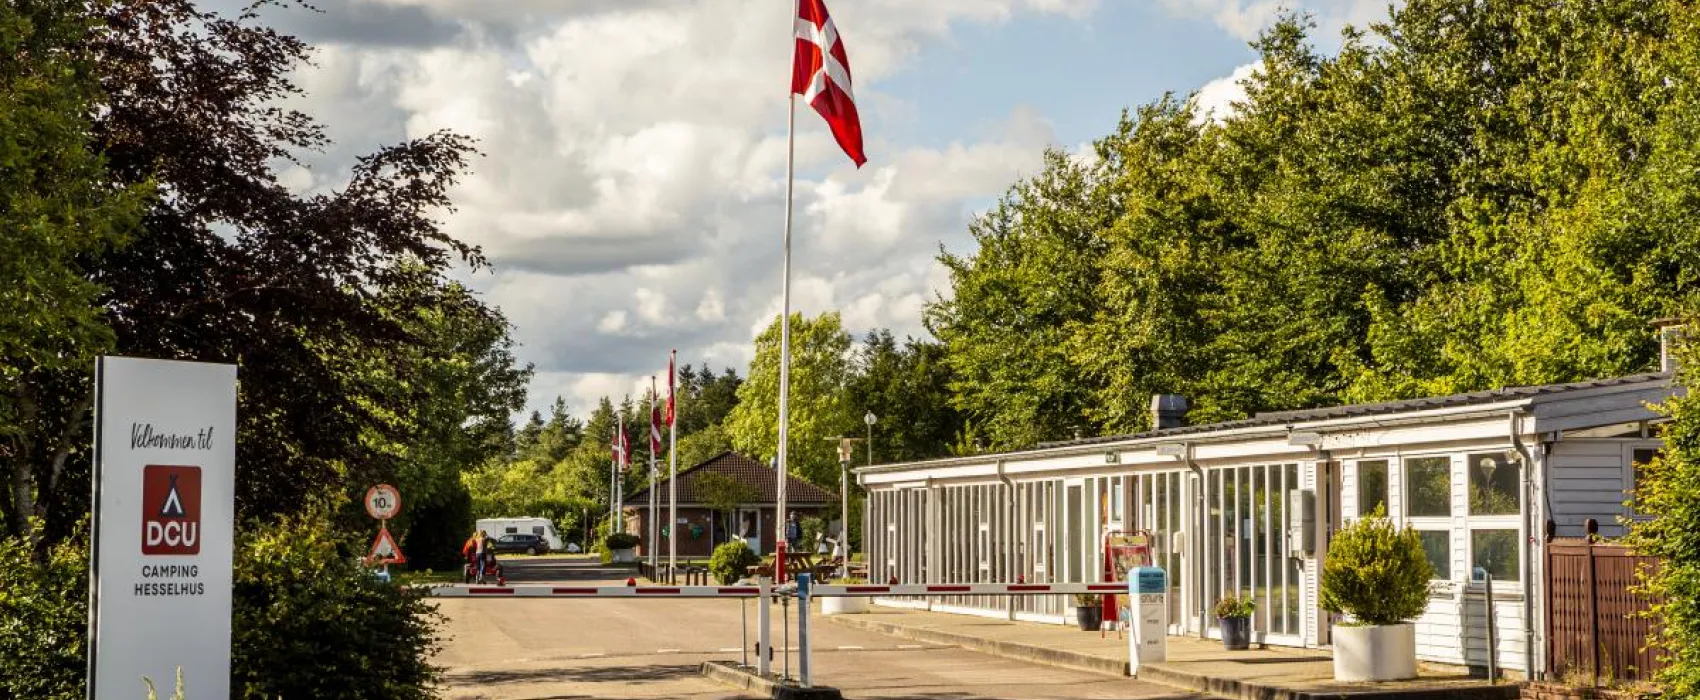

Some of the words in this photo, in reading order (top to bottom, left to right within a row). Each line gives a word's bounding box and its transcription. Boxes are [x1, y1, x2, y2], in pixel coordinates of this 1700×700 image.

[131, 422, 196, 450] Velkommen
[197, 426, 214, 450] til
[373, 497, 386, 509] 10
[146, 521, 197, 547] DCU
[142, 565, 199, 578] CAMPING
[134, 582, 205, 597] HESSELHUS
